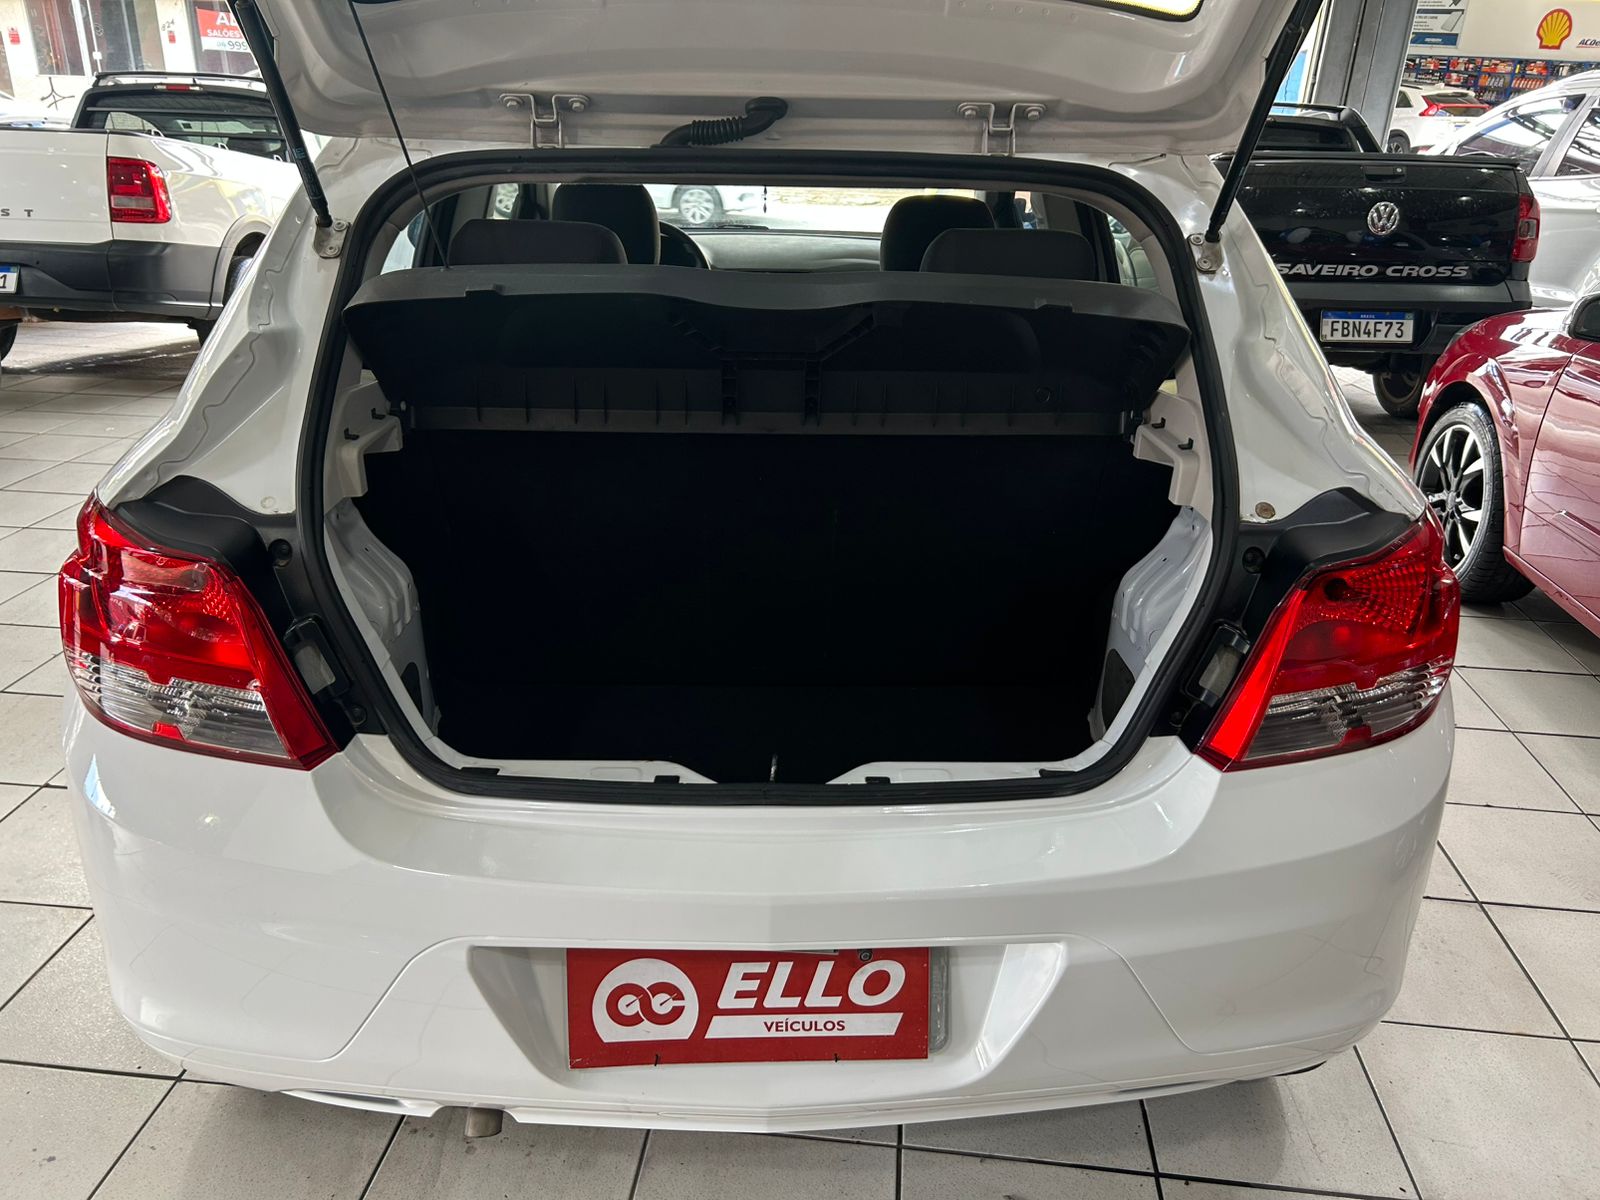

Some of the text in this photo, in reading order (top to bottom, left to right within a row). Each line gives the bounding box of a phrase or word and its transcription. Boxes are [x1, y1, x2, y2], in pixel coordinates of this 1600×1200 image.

[1278, 263, 1470, 277] SAVEIRO CROSS
[1330, 320, 1405, 338] FBN4F73
[717, 959, 906, 1009] ELLO
[763, 1018, 846, 1032] VEÍCULOS
